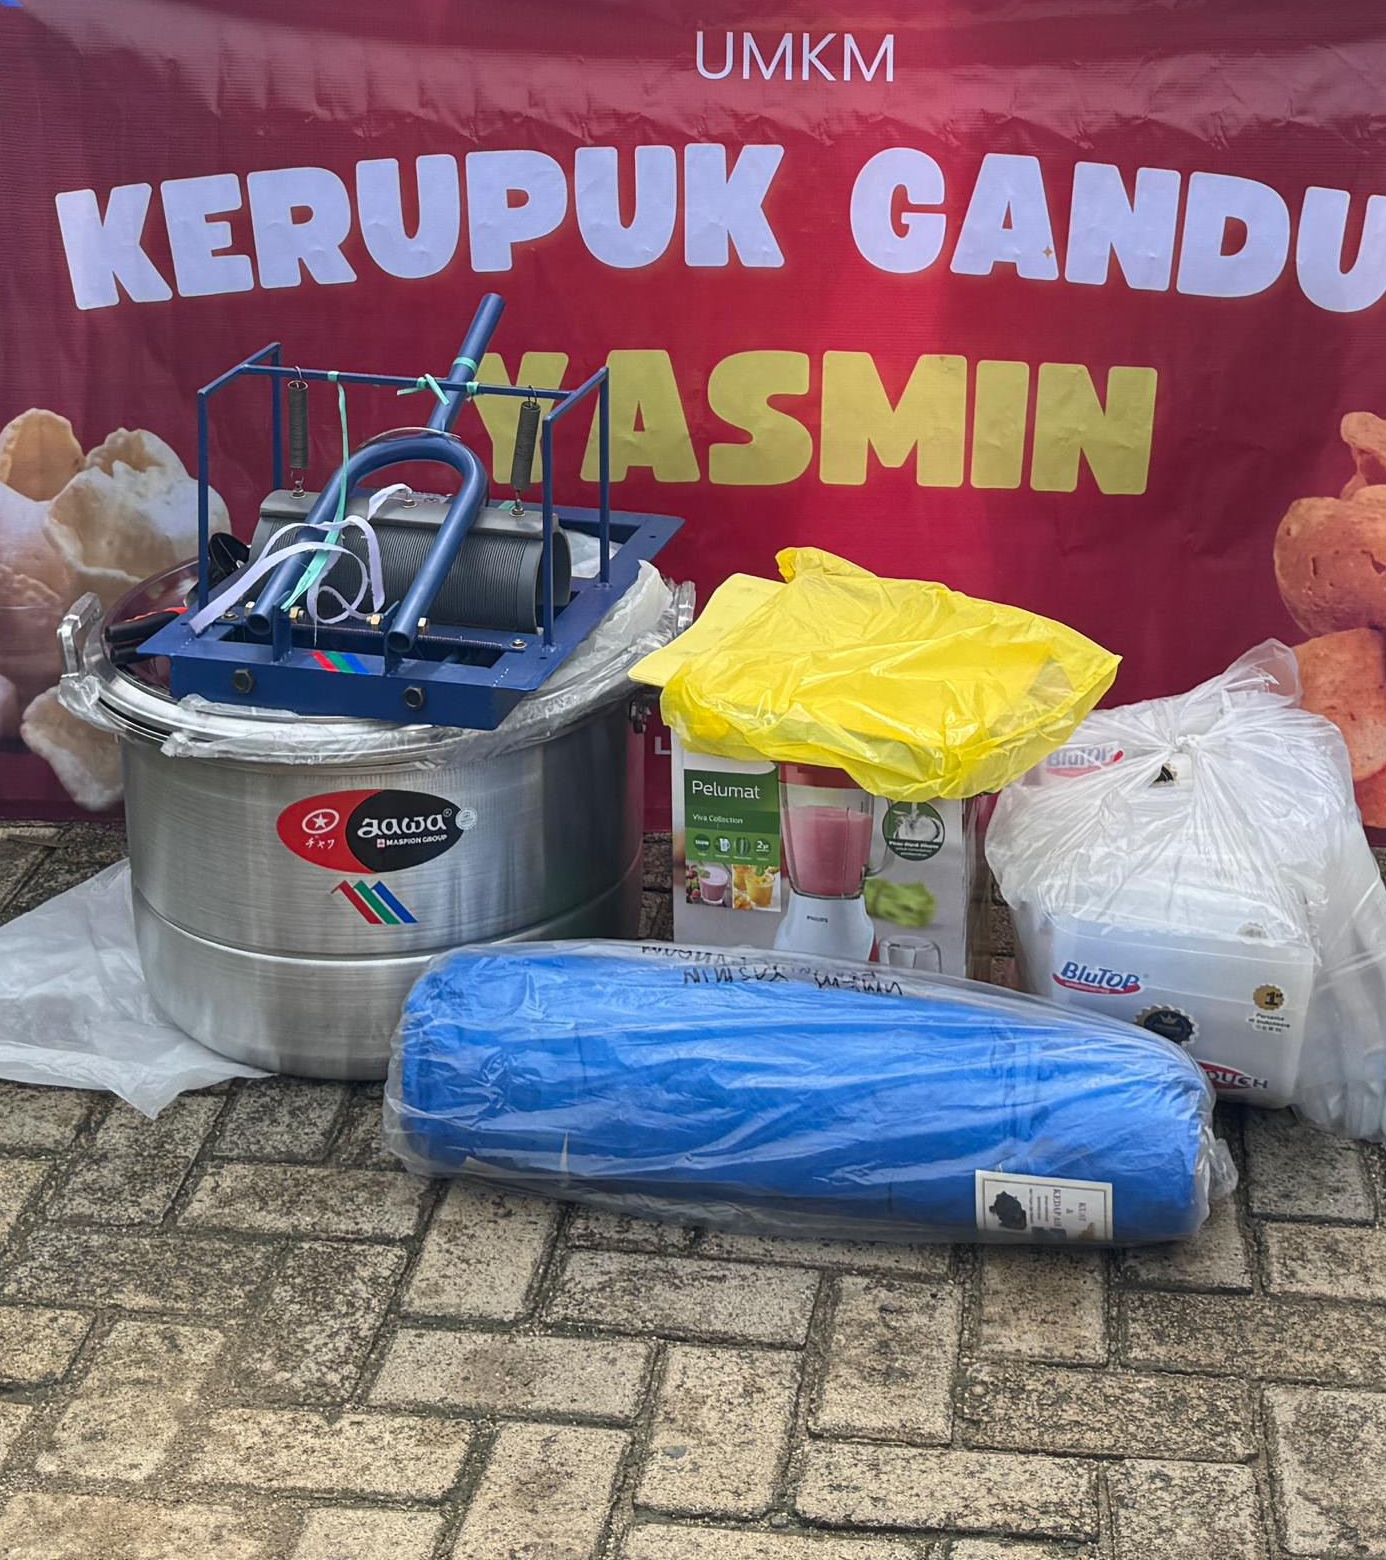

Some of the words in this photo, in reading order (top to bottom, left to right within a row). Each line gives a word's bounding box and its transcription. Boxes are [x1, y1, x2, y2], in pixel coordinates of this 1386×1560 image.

[695, 30, 895, 83] UMKM
[55, 143, 784, 310] KERUPUK
[469, 348, 1158, 496] YASMIN
[692, 780, 761, 800] Pelumat
[692, 813, 708, 822] Viva
[709, 814, 744, 825] Collection
[386, 837, 422, 847] MASPION
[422, 833, 448, 844] GROUP
[683, 965, 790, 985] YASMIN
